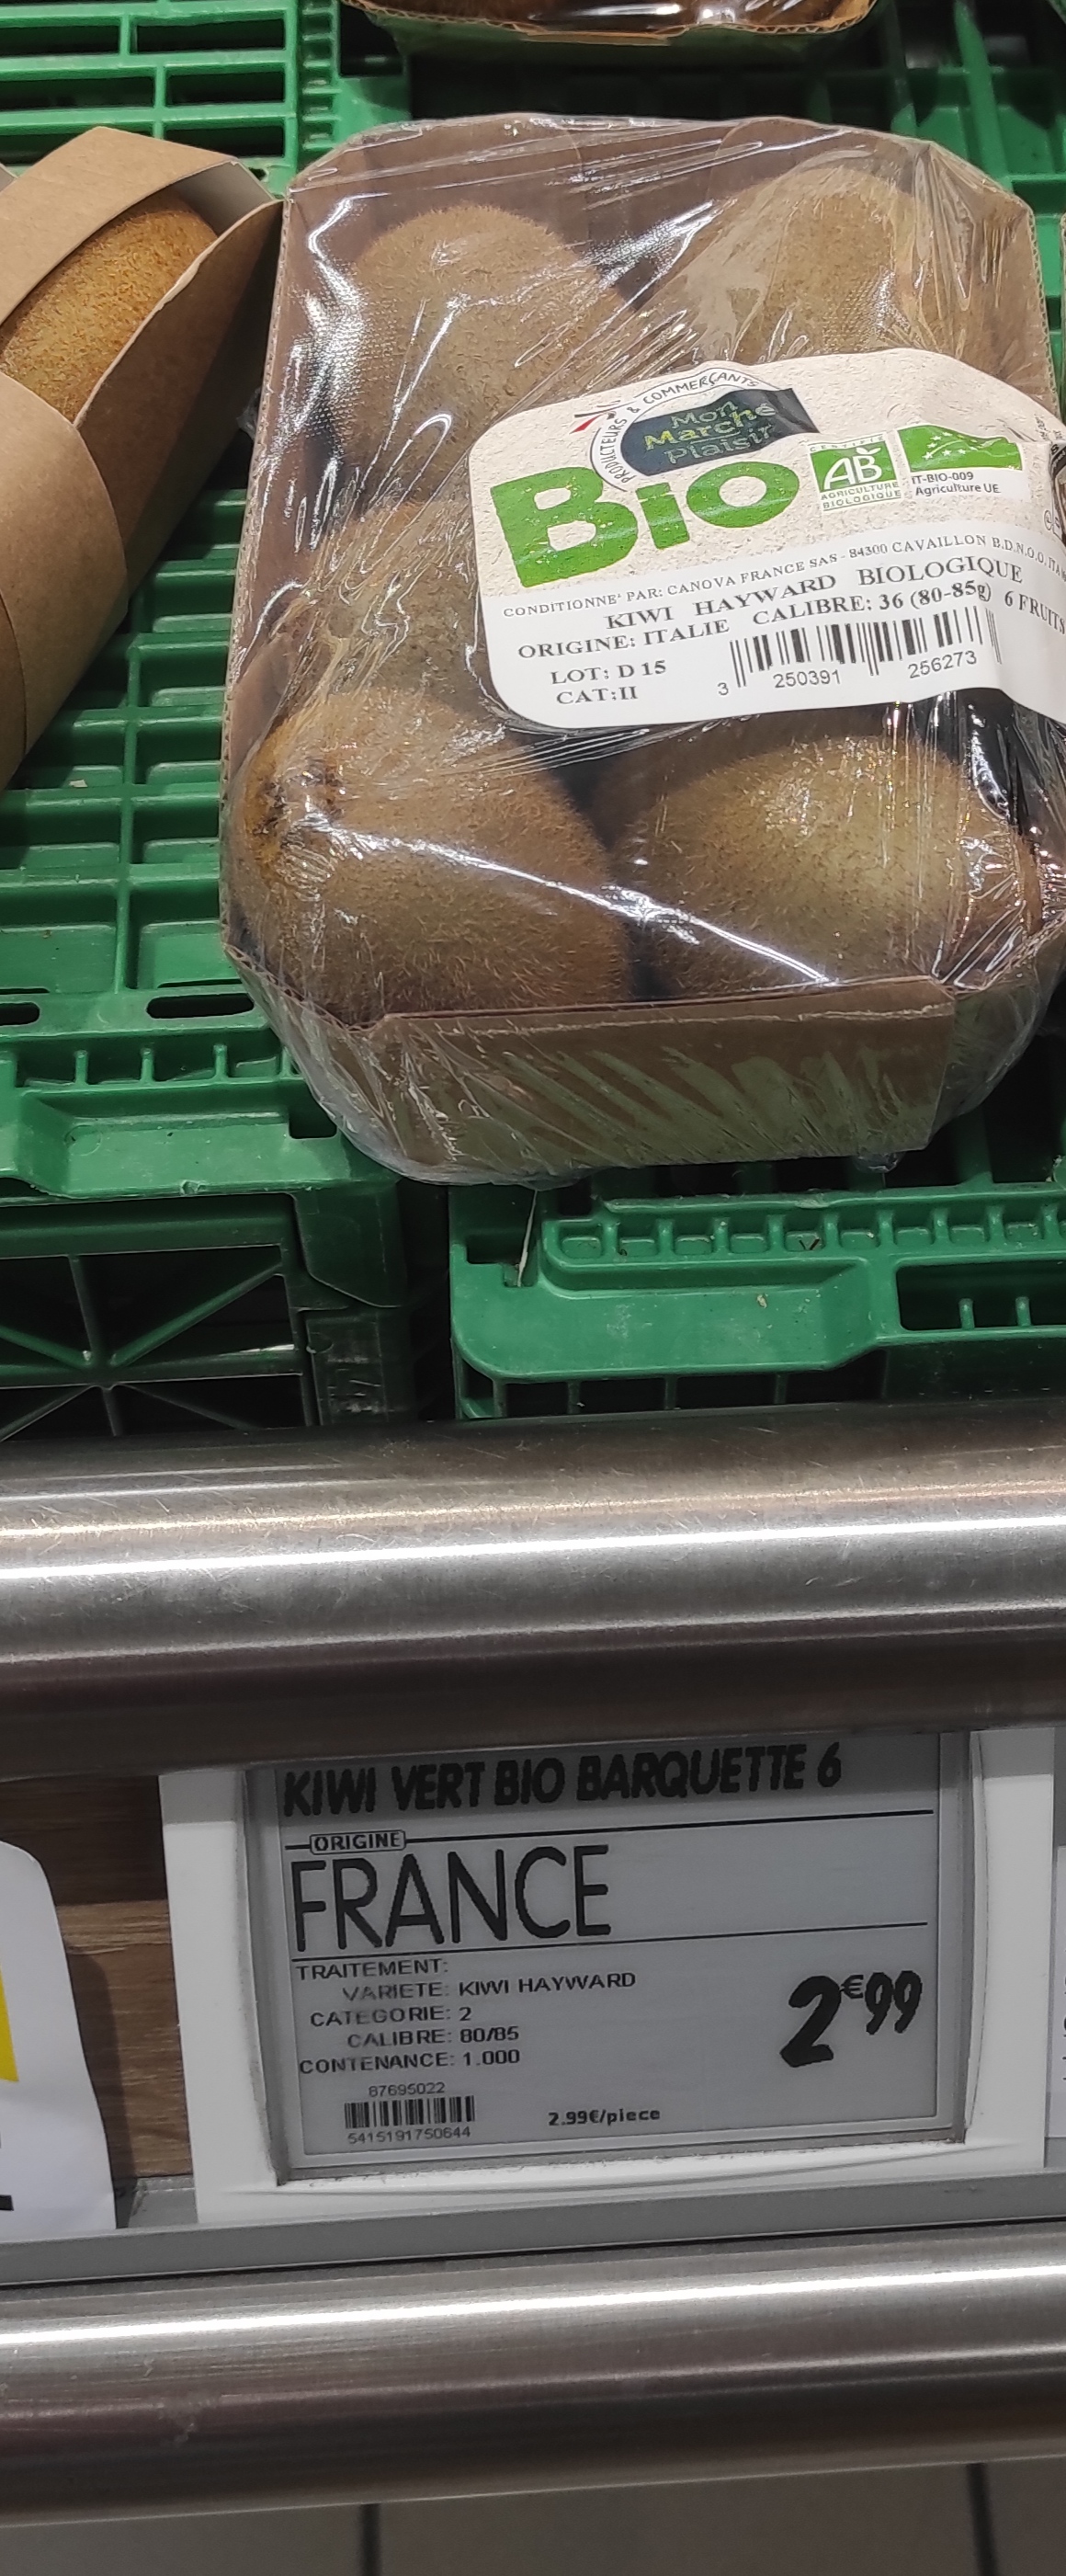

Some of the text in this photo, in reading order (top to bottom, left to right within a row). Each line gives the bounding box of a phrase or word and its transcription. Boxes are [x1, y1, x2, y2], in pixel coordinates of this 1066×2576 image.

[600, 371, 760, 483] PRODUCTEURS & COMMERÇANTS
[644, 403, 777, 451] Marché
[671, 401, 739, 429] Mon
[823, 455, 882, 491] AB
[911, 471, 974, 485] IT-BIO-009
[821, 482, 900, 500] AGRICULTURE
[822, 490, 902, 509] BIOLOGIQUE
[915, 483, 1001, 497] Agriculture UE
[627, 587, 663, 603] PAR:
[667, 576, 736, 596] CANOVA
[741, 561, 805, 585] FRANCE
[809, 553, 838, 569] SAS
[848, 543, 889, 558] 84300
[892, 534, 987, 553] CAVAILLON
[603, 555, 1024, 630] KIWI HAYWARD BIOLOGIQUE
[518, 579, 1066, 658] ORIGINE: ITALIE CALIBRE: 36 (80-85g) 6 FRUITS
[550, 659, 667, 685] LOT: D 15
[717, 650, 978, 697] 3 250391 256273
[284, 1742, 843, 1818] KIWI VERT BIO BARQUETTE 6
[313, 1830, 402, 1852] ORIGINE
[290, 1844, 612, 1952] FRANCE
[296, 1957, 448, 1980] TRAITEMENT:
[343, 1972, 636, 2001] VARIETE: KIWI HAYWARD
[311, 2005, 473, 2027] CATEGORIE: 2
[347, 2025, 520, 2048] CALIBRE: 80/85
[300, 2049, 521, 2075] CONTENANCE: 1.000
[369, 2081, 446, 2098] 87695022
